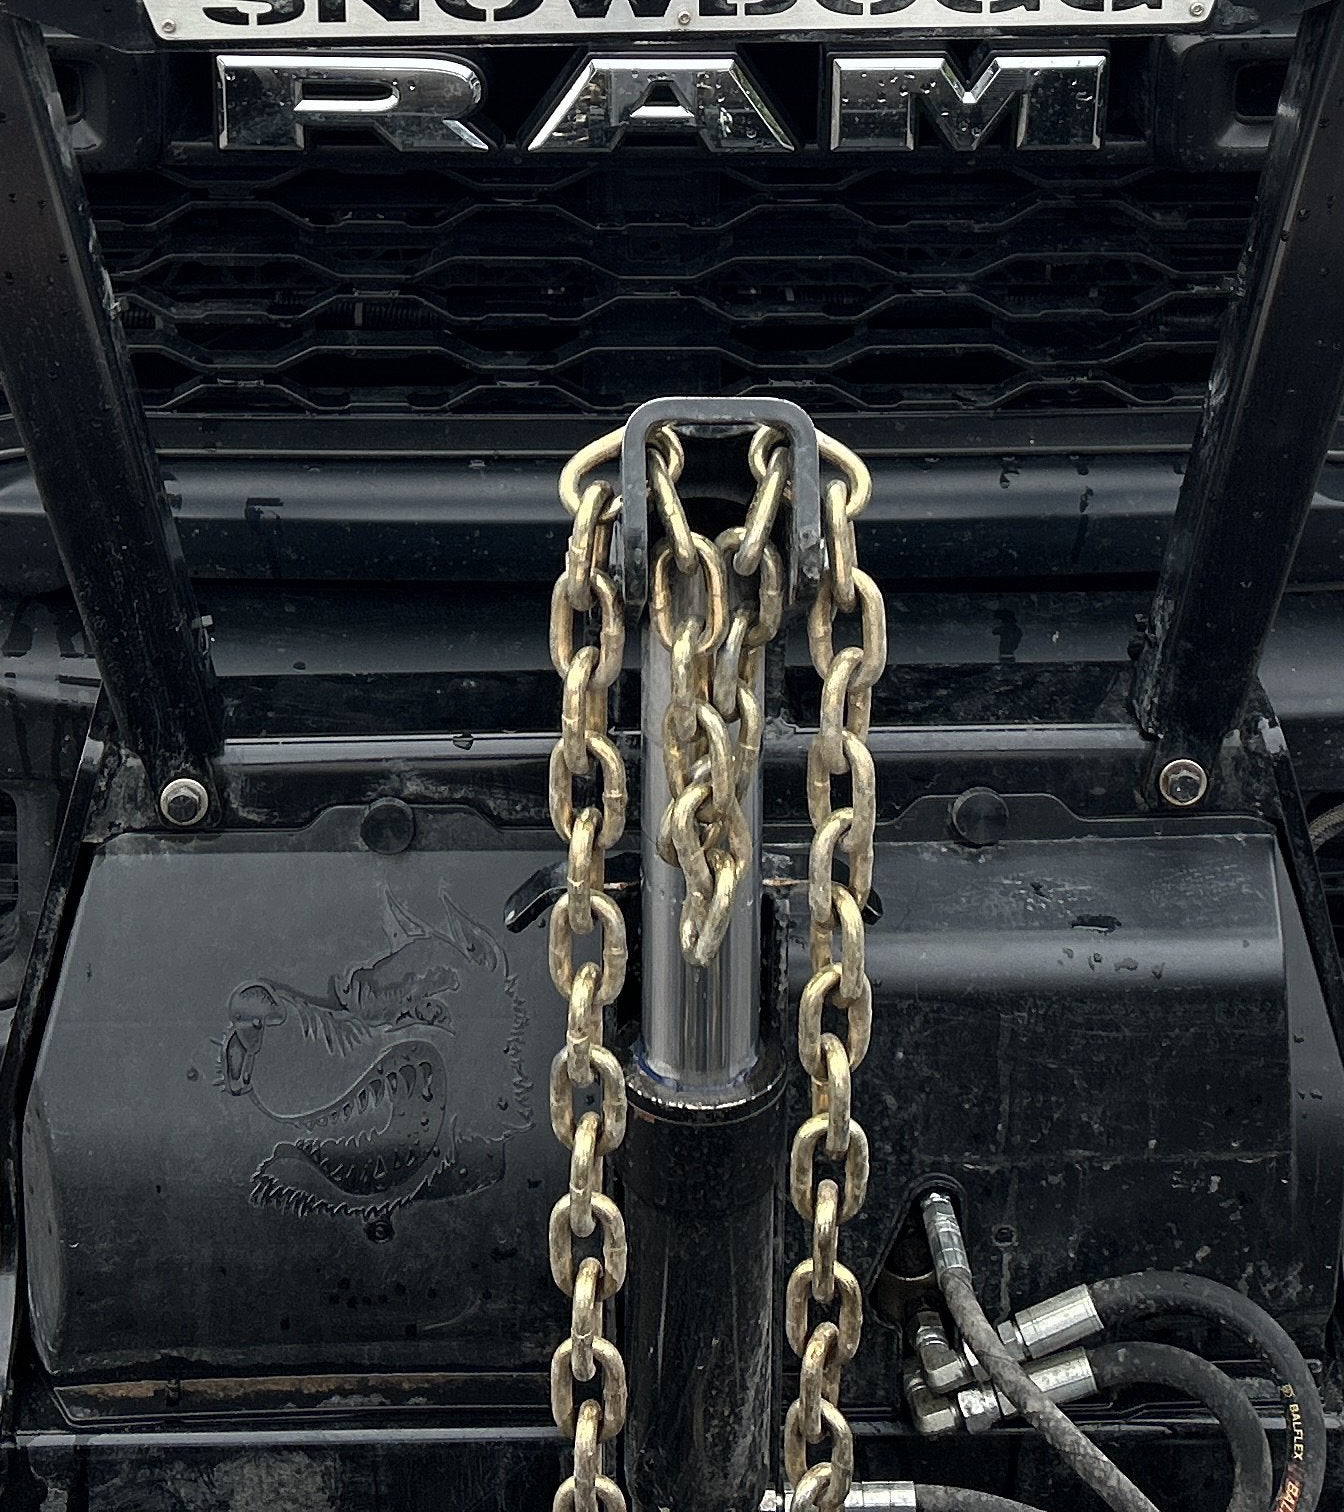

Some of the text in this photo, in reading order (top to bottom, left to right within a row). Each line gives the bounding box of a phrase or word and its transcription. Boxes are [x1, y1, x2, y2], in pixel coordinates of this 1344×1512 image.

[216, 51, 1109, 152] RAM
[1288, 1403, 1304, 1462] BALFLEX
[1278, 1480, 1300, 1512] BAL
